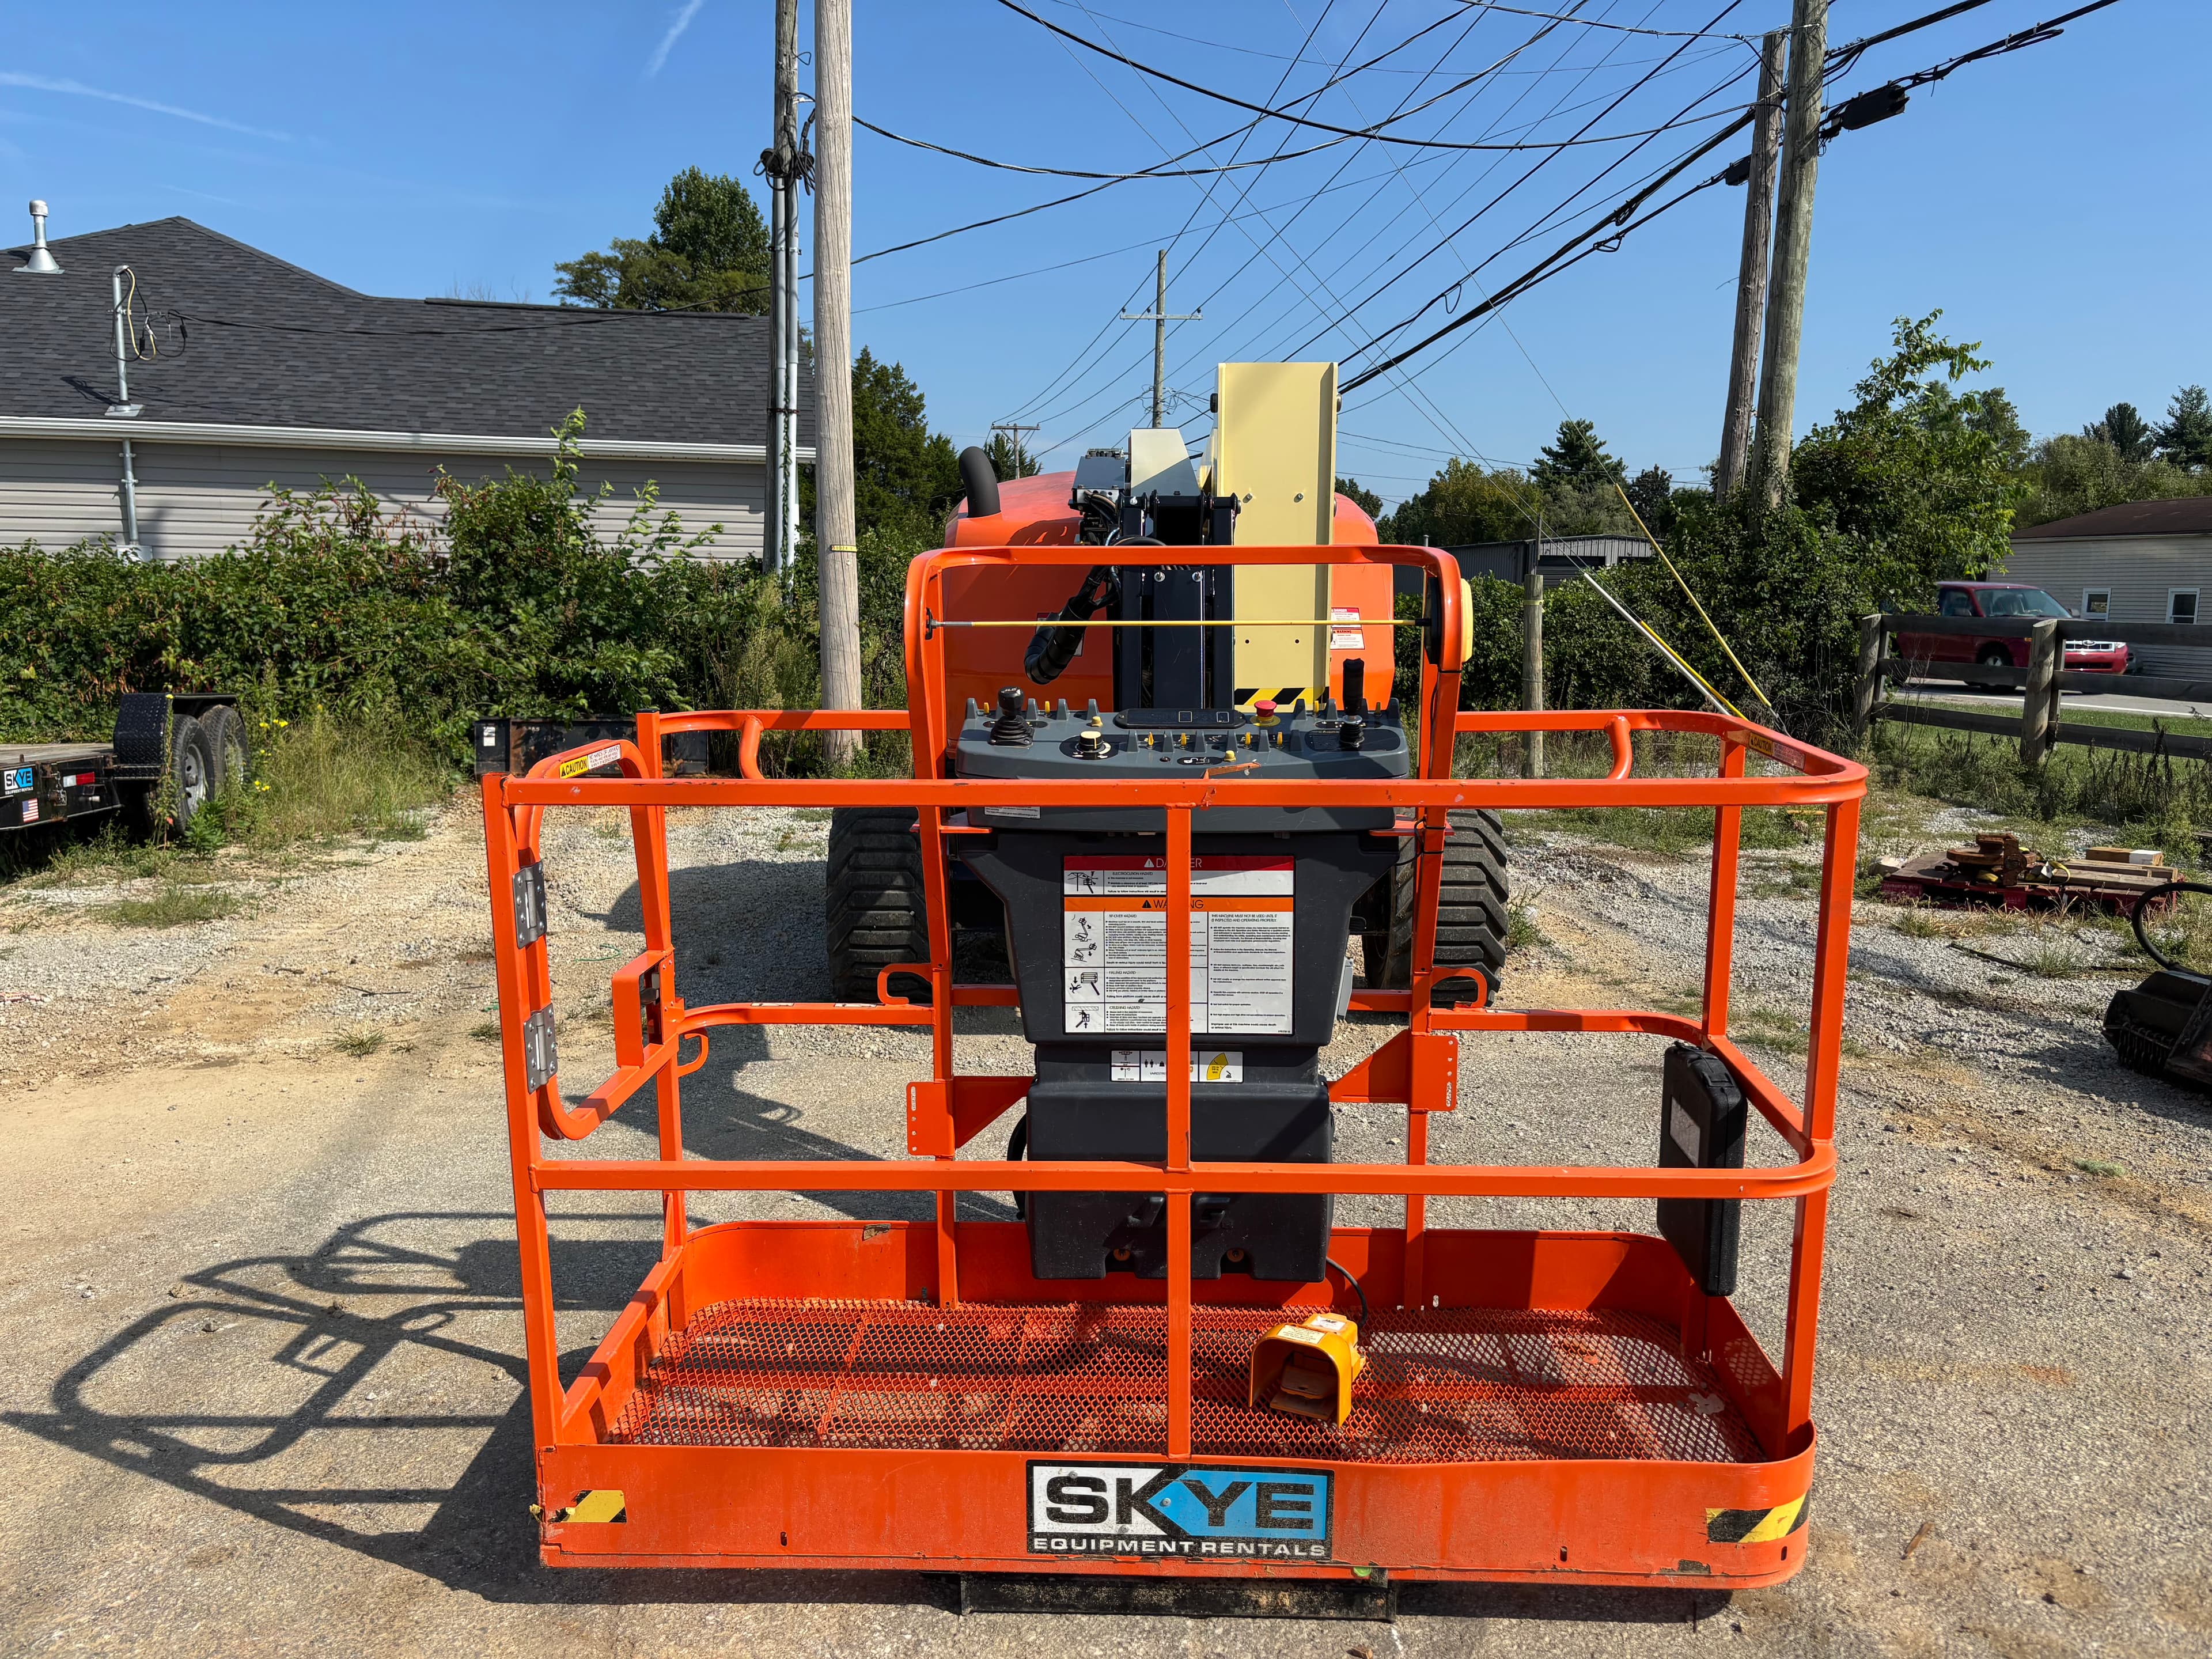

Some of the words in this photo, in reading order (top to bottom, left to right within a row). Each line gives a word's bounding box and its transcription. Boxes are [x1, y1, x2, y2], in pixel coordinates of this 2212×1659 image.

[565, 758, 588, 775] CAUTION
[6, 771, 32, 787] SKYE
[1156, 858, 1202, 868] DER
[1127, 1195, 1231, 1229] JG
[1046, 1475, 1315, 1532] SKYE
[1033, 1537, 1195, 1554] EQUIPMENT
[1201, 1541, 1326, 1556] RENTALS
